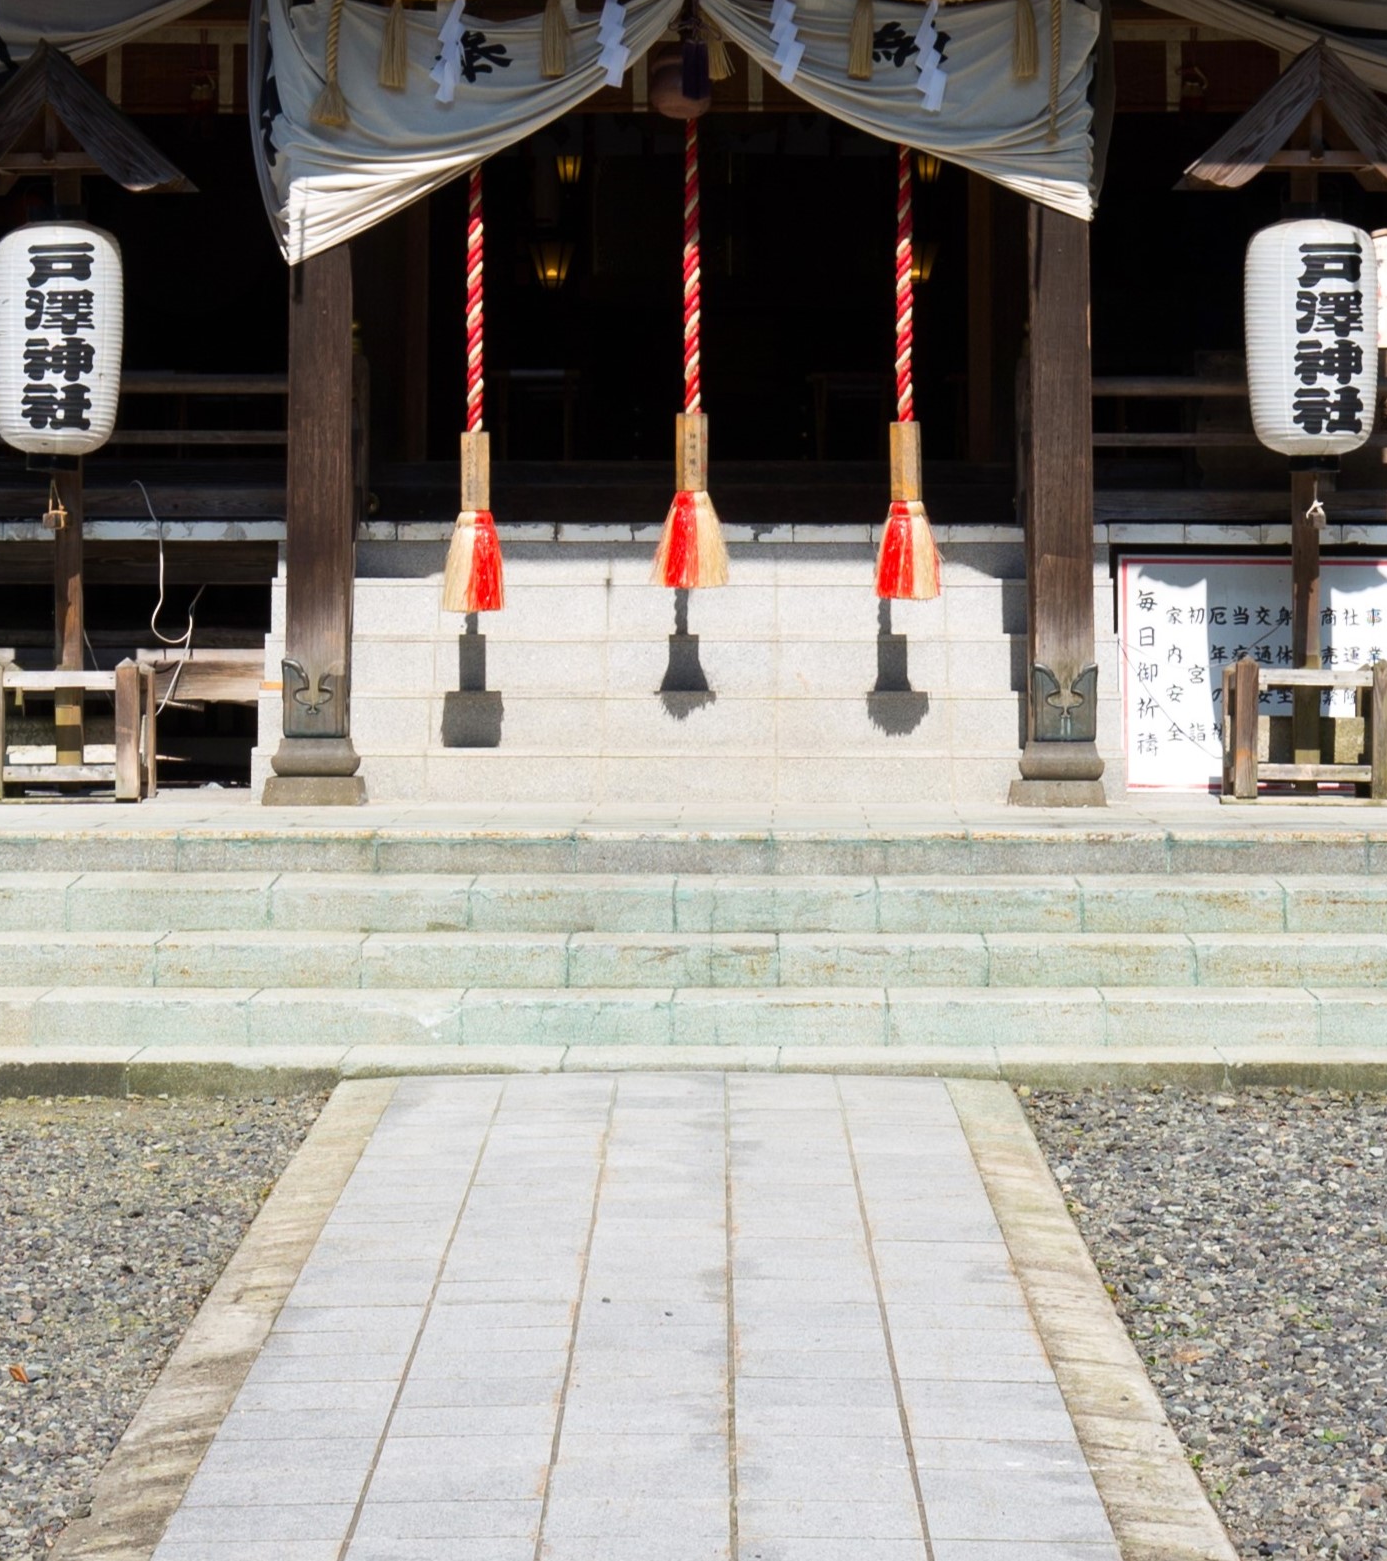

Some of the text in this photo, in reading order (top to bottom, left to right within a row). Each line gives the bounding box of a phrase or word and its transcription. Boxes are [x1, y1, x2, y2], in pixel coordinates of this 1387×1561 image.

[21, 241, 95, 431] 戸澤神社
[1293, 242, 1364, 435] 戸澤神社
[1166, 606, 1184, 742] 家内安全
[1188, 607, 1206, 742] 初宮詣
